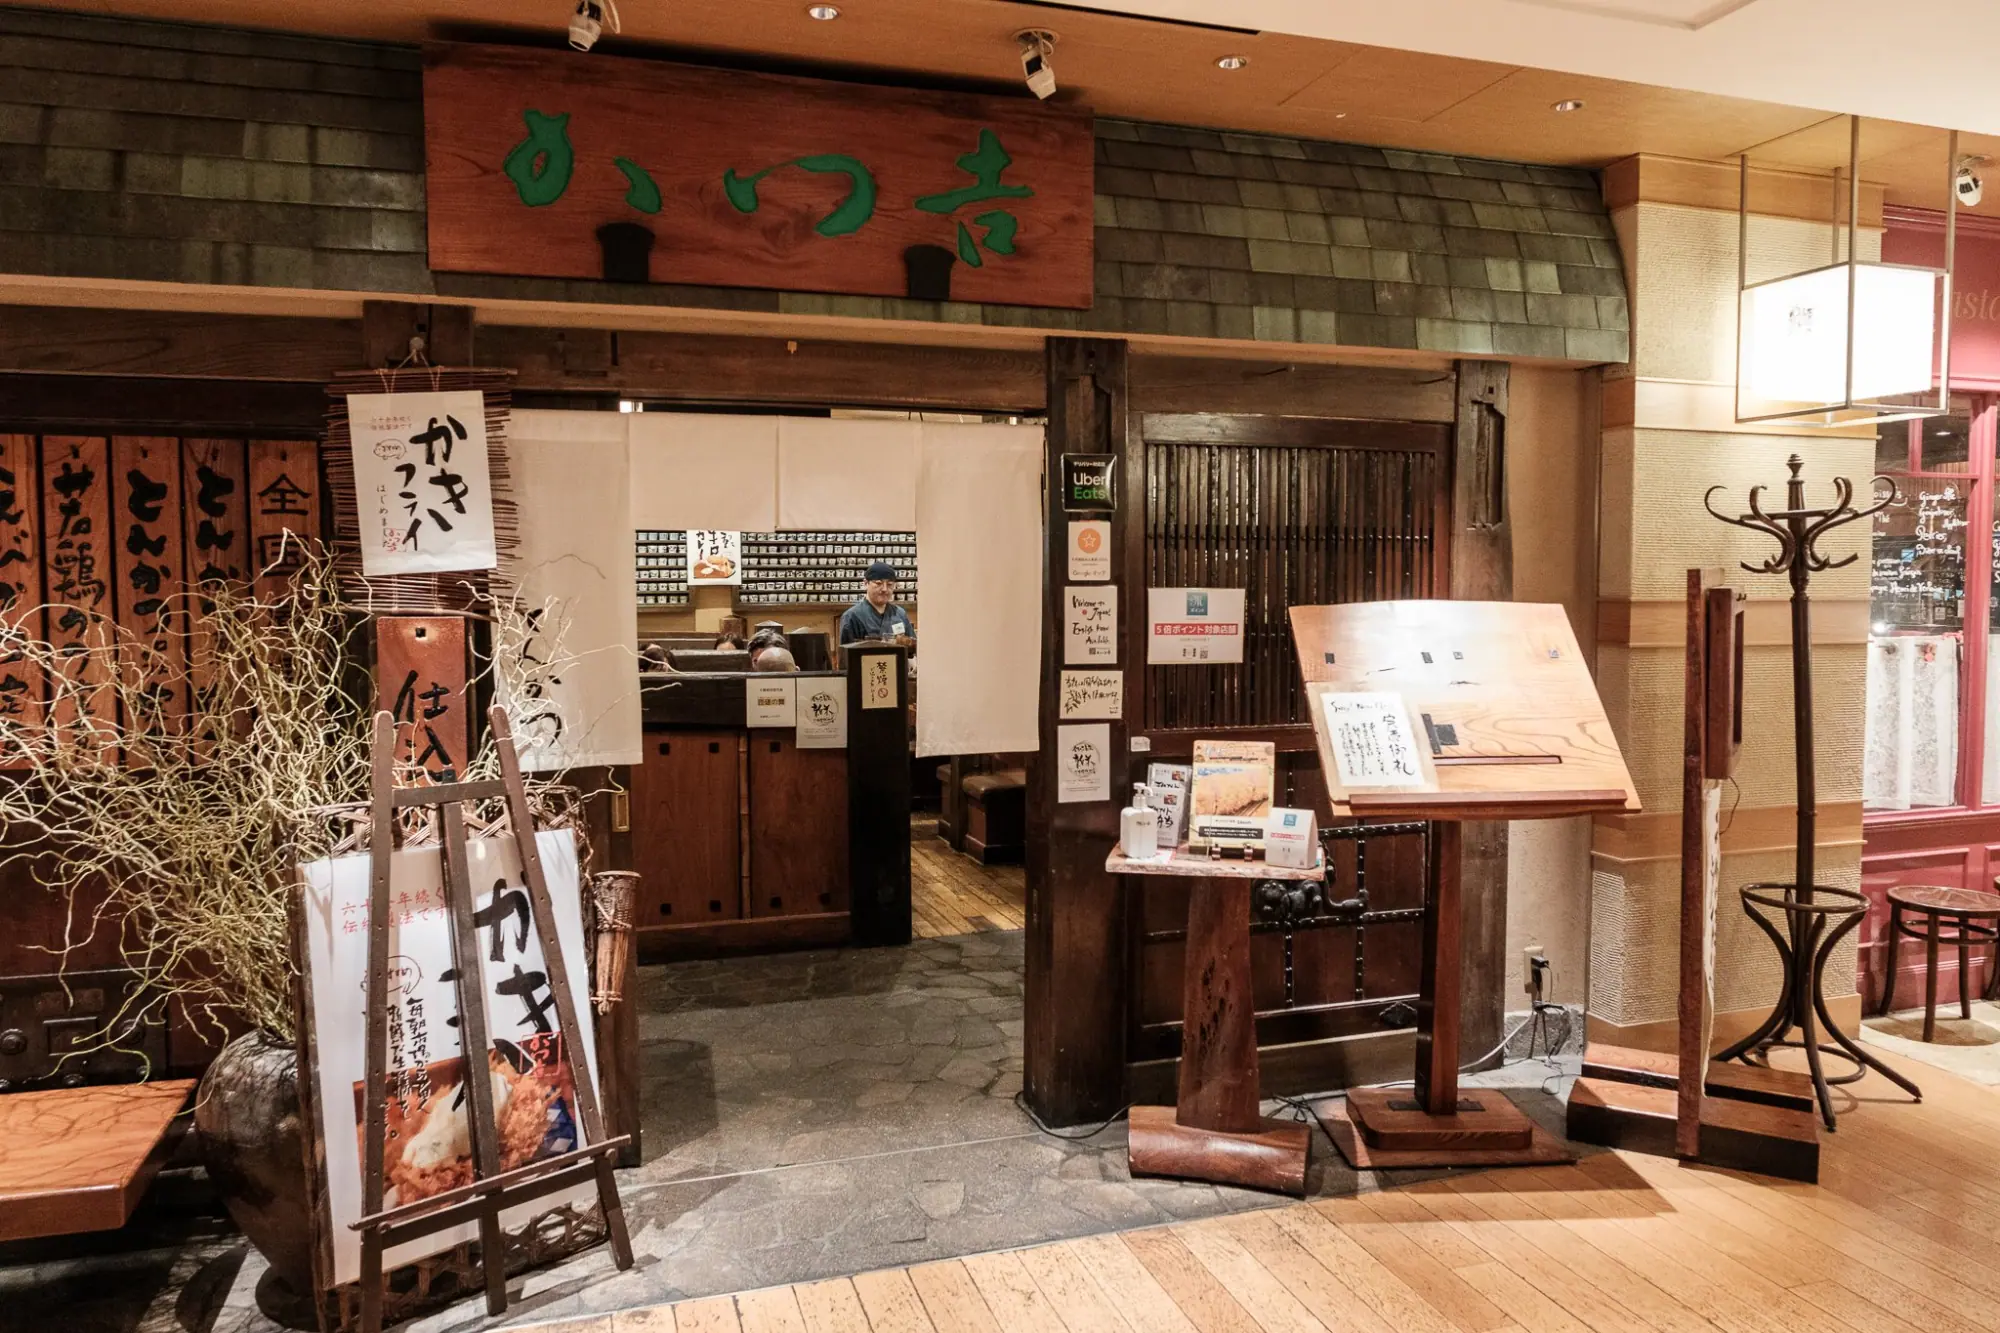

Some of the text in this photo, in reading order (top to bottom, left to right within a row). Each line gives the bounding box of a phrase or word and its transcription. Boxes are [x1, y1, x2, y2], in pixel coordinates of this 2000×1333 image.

[1073, 472, 1107, 486] Uber
[1073, 486, 1106, 500] Eats
[394, 463, 422, 552] フライ
[340, 886, 445, 917] 六十年続く
